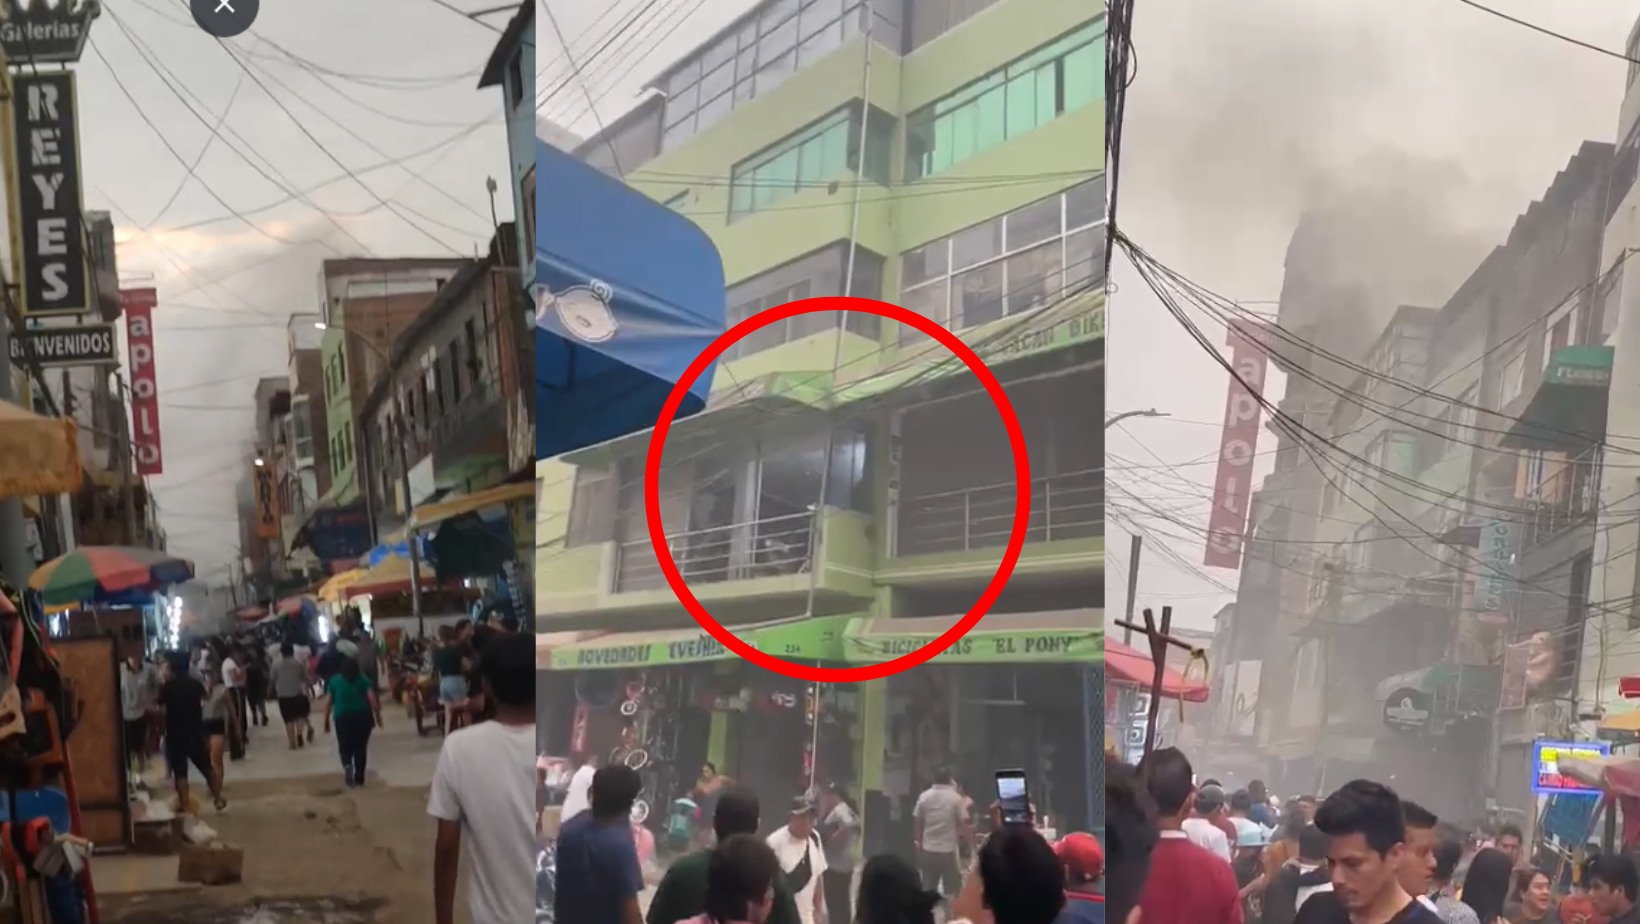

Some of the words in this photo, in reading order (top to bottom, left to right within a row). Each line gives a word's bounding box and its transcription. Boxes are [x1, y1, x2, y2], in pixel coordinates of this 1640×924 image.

[27, 84, 69, 301] REYES
[10, 332, 110, 358] BINVENIDOS
[130, 315, 160, 464] apolo
[1210, 356, 1261, 556] apolo
